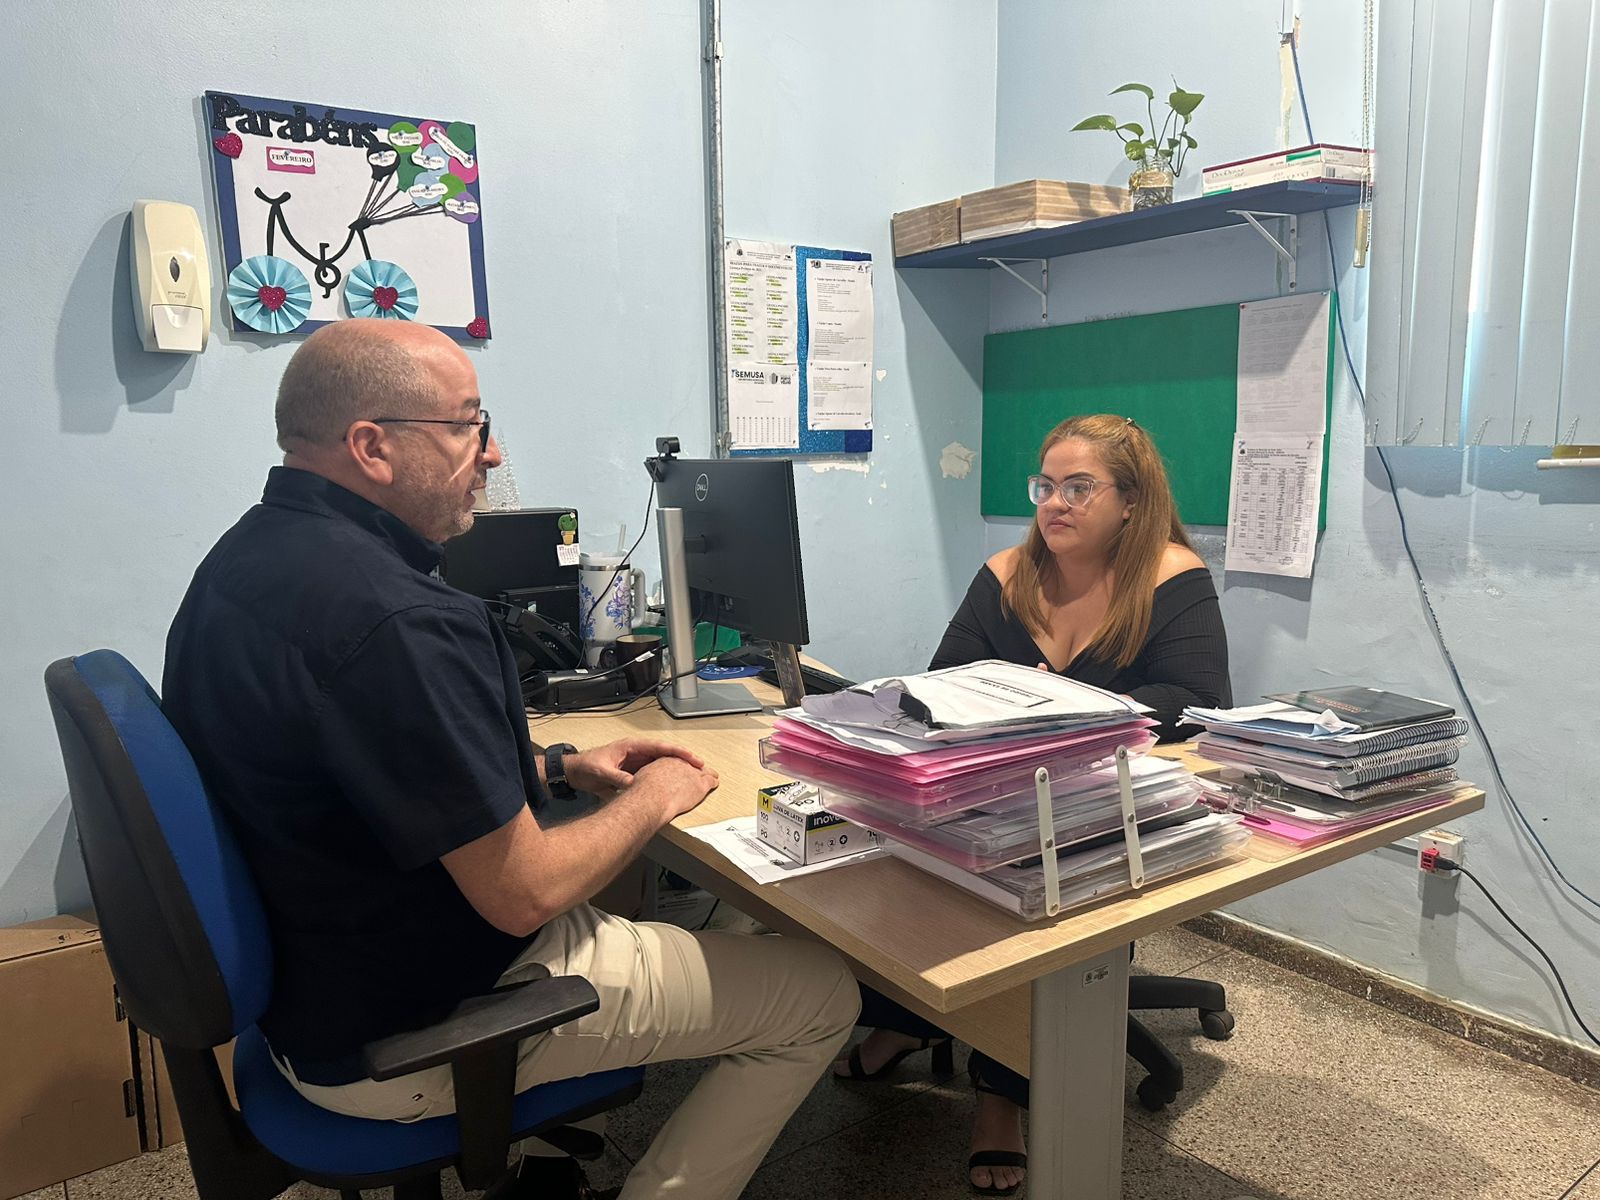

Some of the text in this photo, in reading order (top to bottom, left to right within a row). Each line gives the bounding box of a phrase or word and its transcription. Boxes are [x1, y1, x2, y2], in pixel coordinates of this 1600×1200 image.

[209, 94, 378, 148] Parabéns
[271, 154, 313, 164] FEVEREIRO
[735, 370, 765, 379] SEMUSA
[762, 796, 769, 809] M
[760, 811, 769, 821] 100
